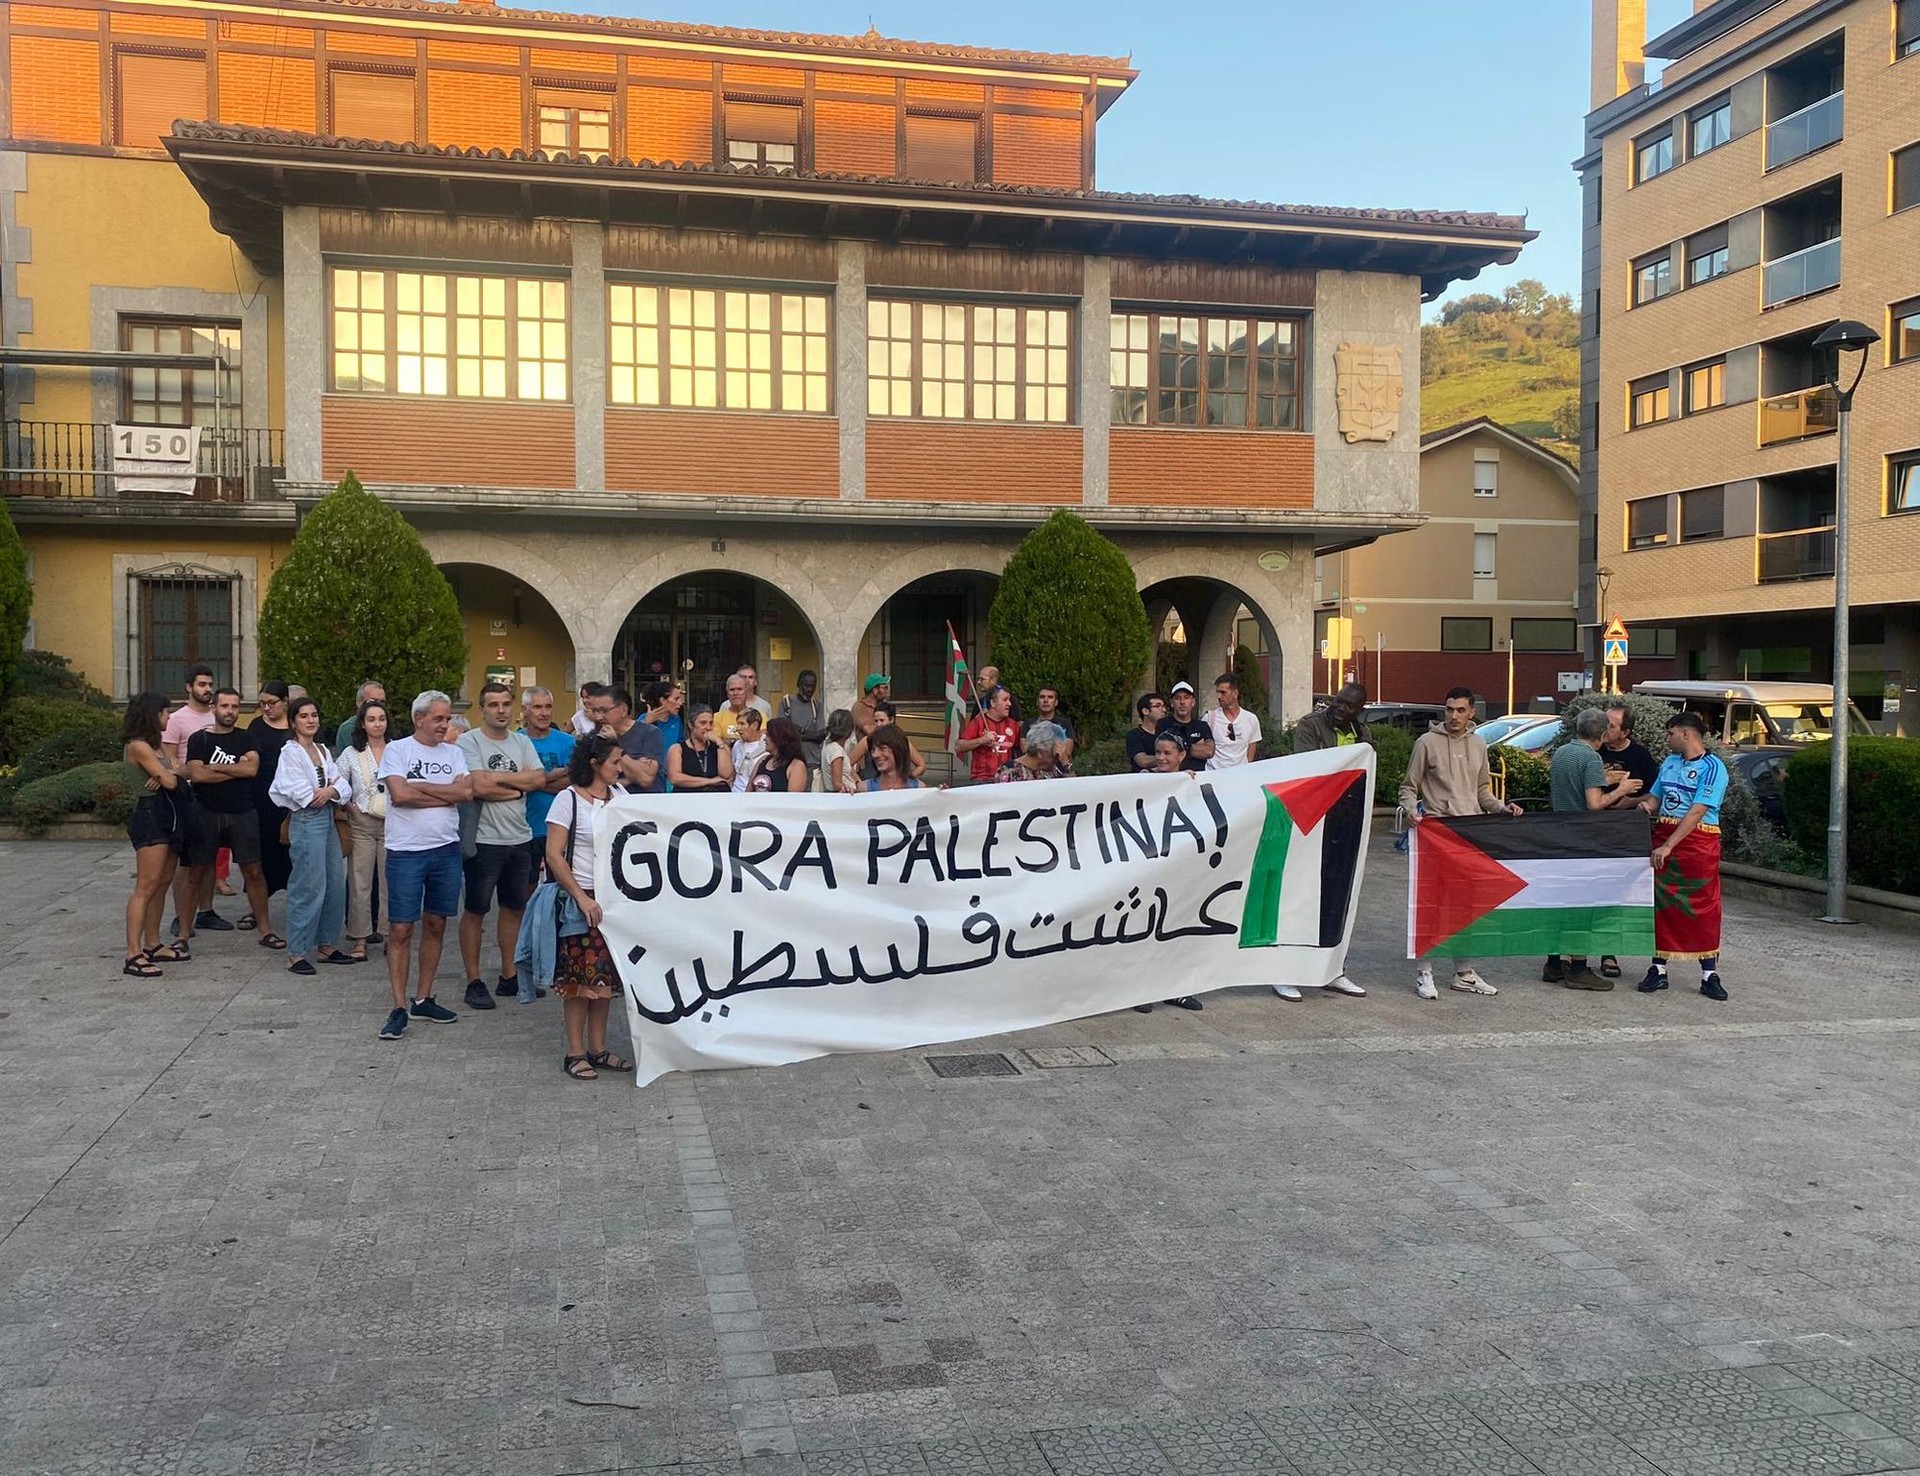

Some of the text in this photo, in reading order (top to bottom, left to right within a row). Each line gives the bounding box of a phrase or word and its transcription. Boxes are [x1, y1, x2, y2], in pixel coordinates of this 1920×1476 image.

[120, 431, 187, 455] 150
[611, 783, 1229, 902] GORA PALESTINA!
[628, 880, 1243, 1025] عاشت فلسطين
